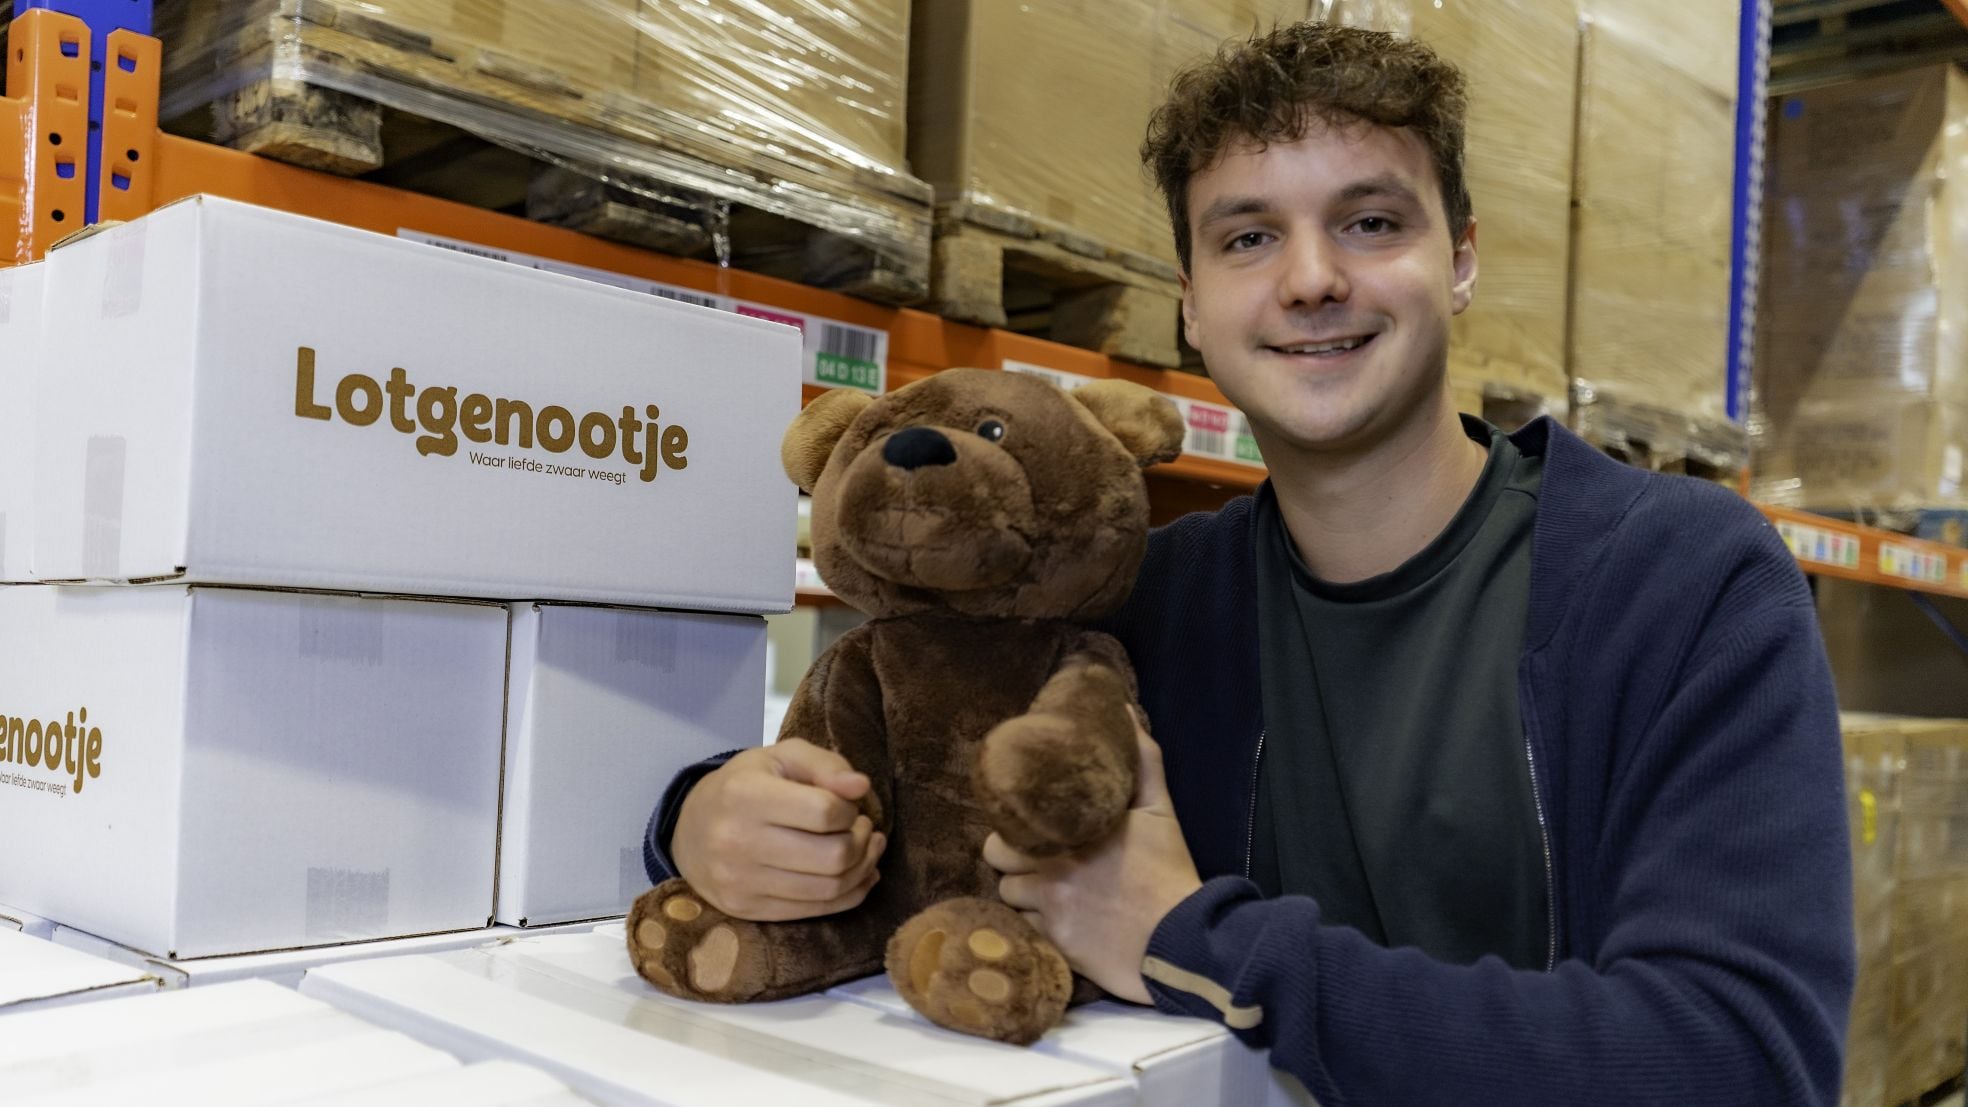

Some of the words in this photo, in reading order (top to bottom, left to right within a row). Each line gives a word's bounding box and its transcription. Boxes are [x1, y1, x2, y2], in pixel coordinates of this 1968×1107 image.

[295, 347, 688, 483] Lotgenootje
[469, 451, 505, 468] Waar
[508, 456, 543, 473] liefde
[545, 464, 586, 478] zwaar
[588, 469, 627, 486] weegt
[12, 772, 27, 788] liefde
